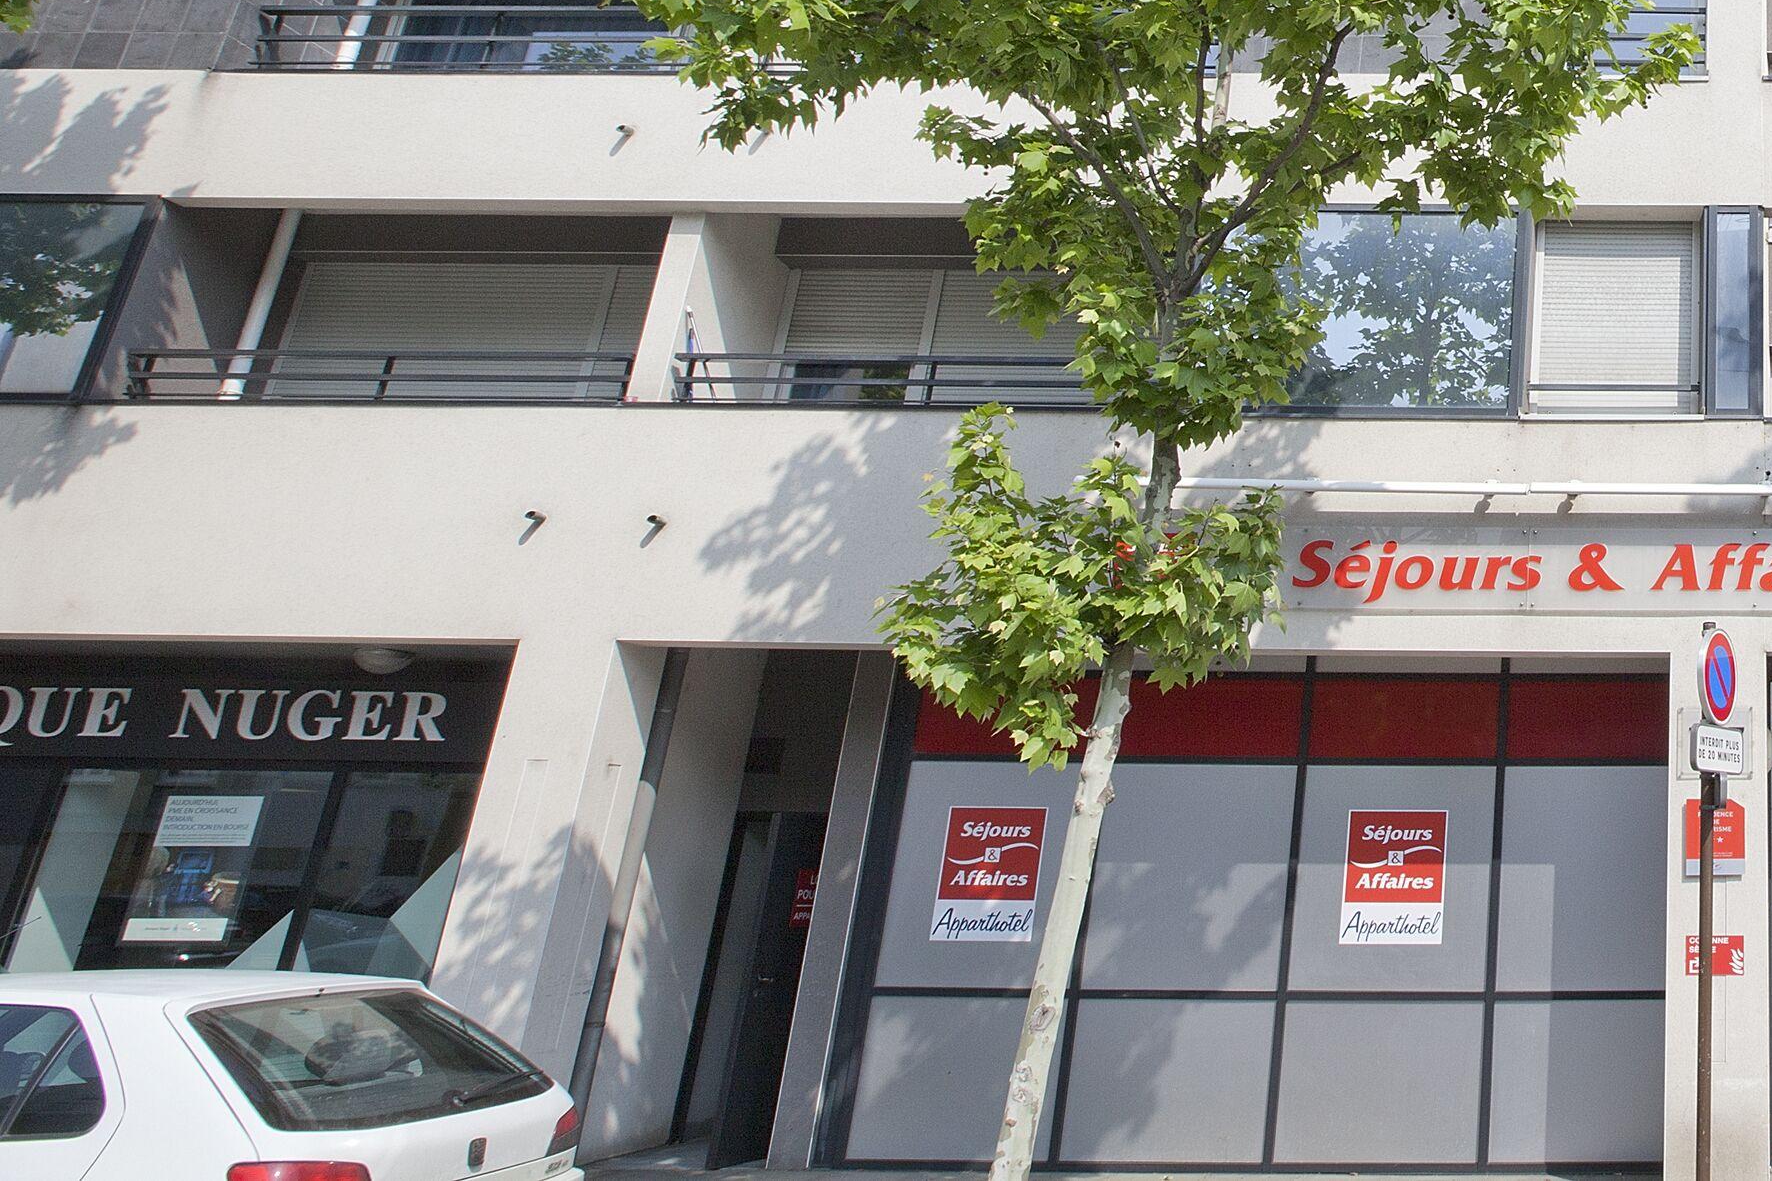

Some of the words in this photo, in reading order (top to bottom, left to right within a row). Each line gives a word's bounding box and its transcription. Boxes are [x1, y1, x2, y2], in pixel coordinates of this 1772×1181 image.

[1292, 539, 1543, 604] Séjours
[1568, 542, 1625, 591] &
[168, 689, 448, 741] NUGER
[1700, 736, 1724, 749] INTERDIT
[1726, 739, 1739, 751] PLUS
[1699, 748, 1706, 759] DE
[1708, 749, 1715, 760] 20
[1717, 751, 1740, 763] MINUTES
[960, 821, 1031, 841] Séjours
[1361, 825, 1433, 845] Séjours
[987, 848, 998, 861] &
[1391, 852, 1401, 864] &
[949, 869, 1029, 887] Affaires
[1355, 872, 1434, 890] Affaires
[932, 907, 1034, 940] Apparthotel
[1341, 910, 1442, 942] Apparthotel
[1689, 937, 1729, 945] CONNE
[1689, 945, 1717, 953] SÈE
